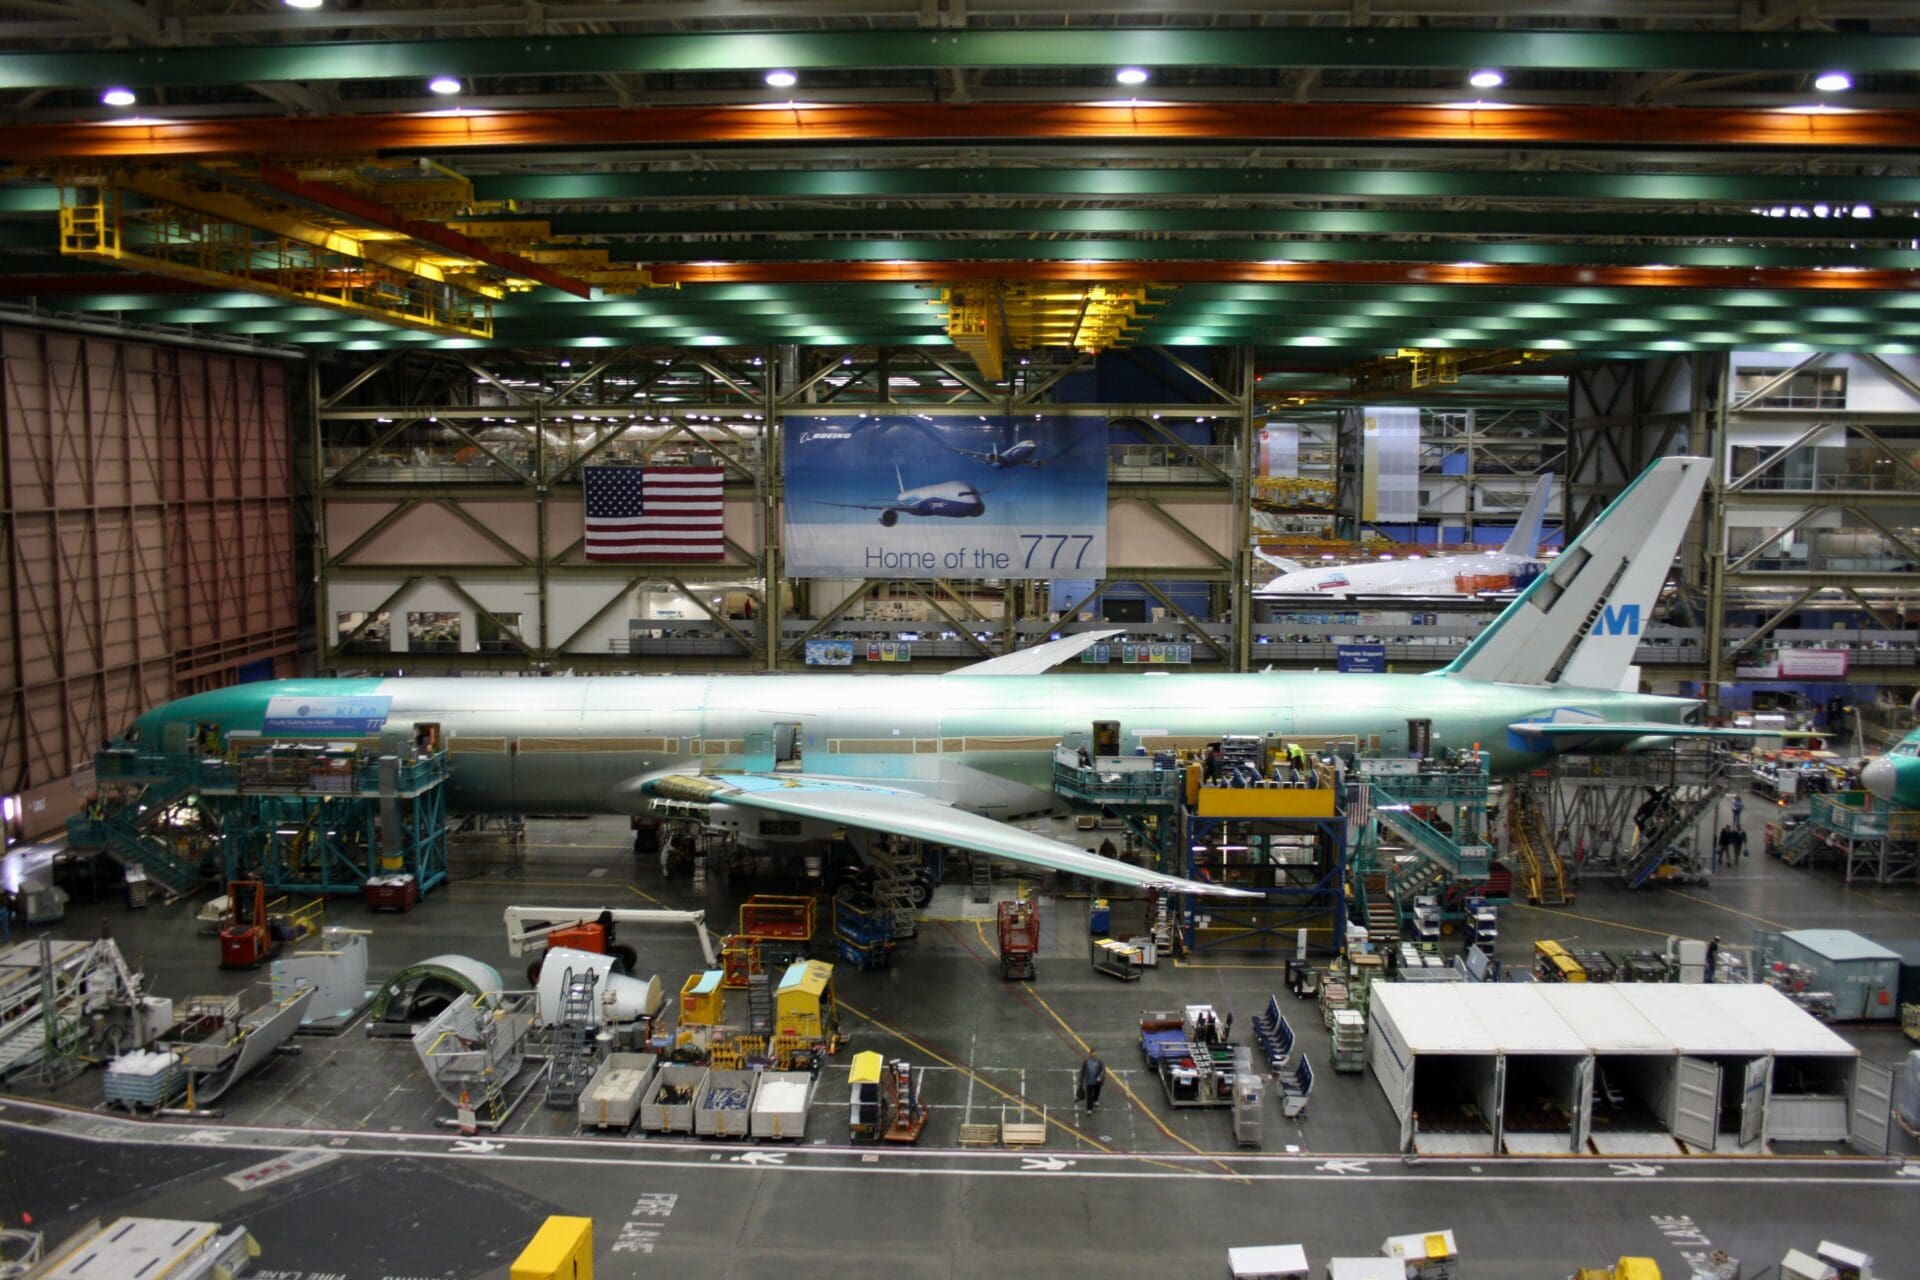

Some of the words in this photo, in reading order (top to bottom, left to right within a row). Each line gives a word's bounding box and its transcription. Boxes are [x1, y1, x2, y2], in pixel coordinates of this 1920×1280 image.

[865, 547, 935, 569] Home
[943, 547, 967, 569] of
[973, 548, 1009, 569] the
[1020, 534, 1094, 570] 777
[1591, 604, 1640, 636] M
[336, 706, 376, 717] KLM
[631, 1193, 679, 1217] FIRE
[611, 1221, 665, 1253] LANE
[1650, 1215, 1711, 1246] LANE
